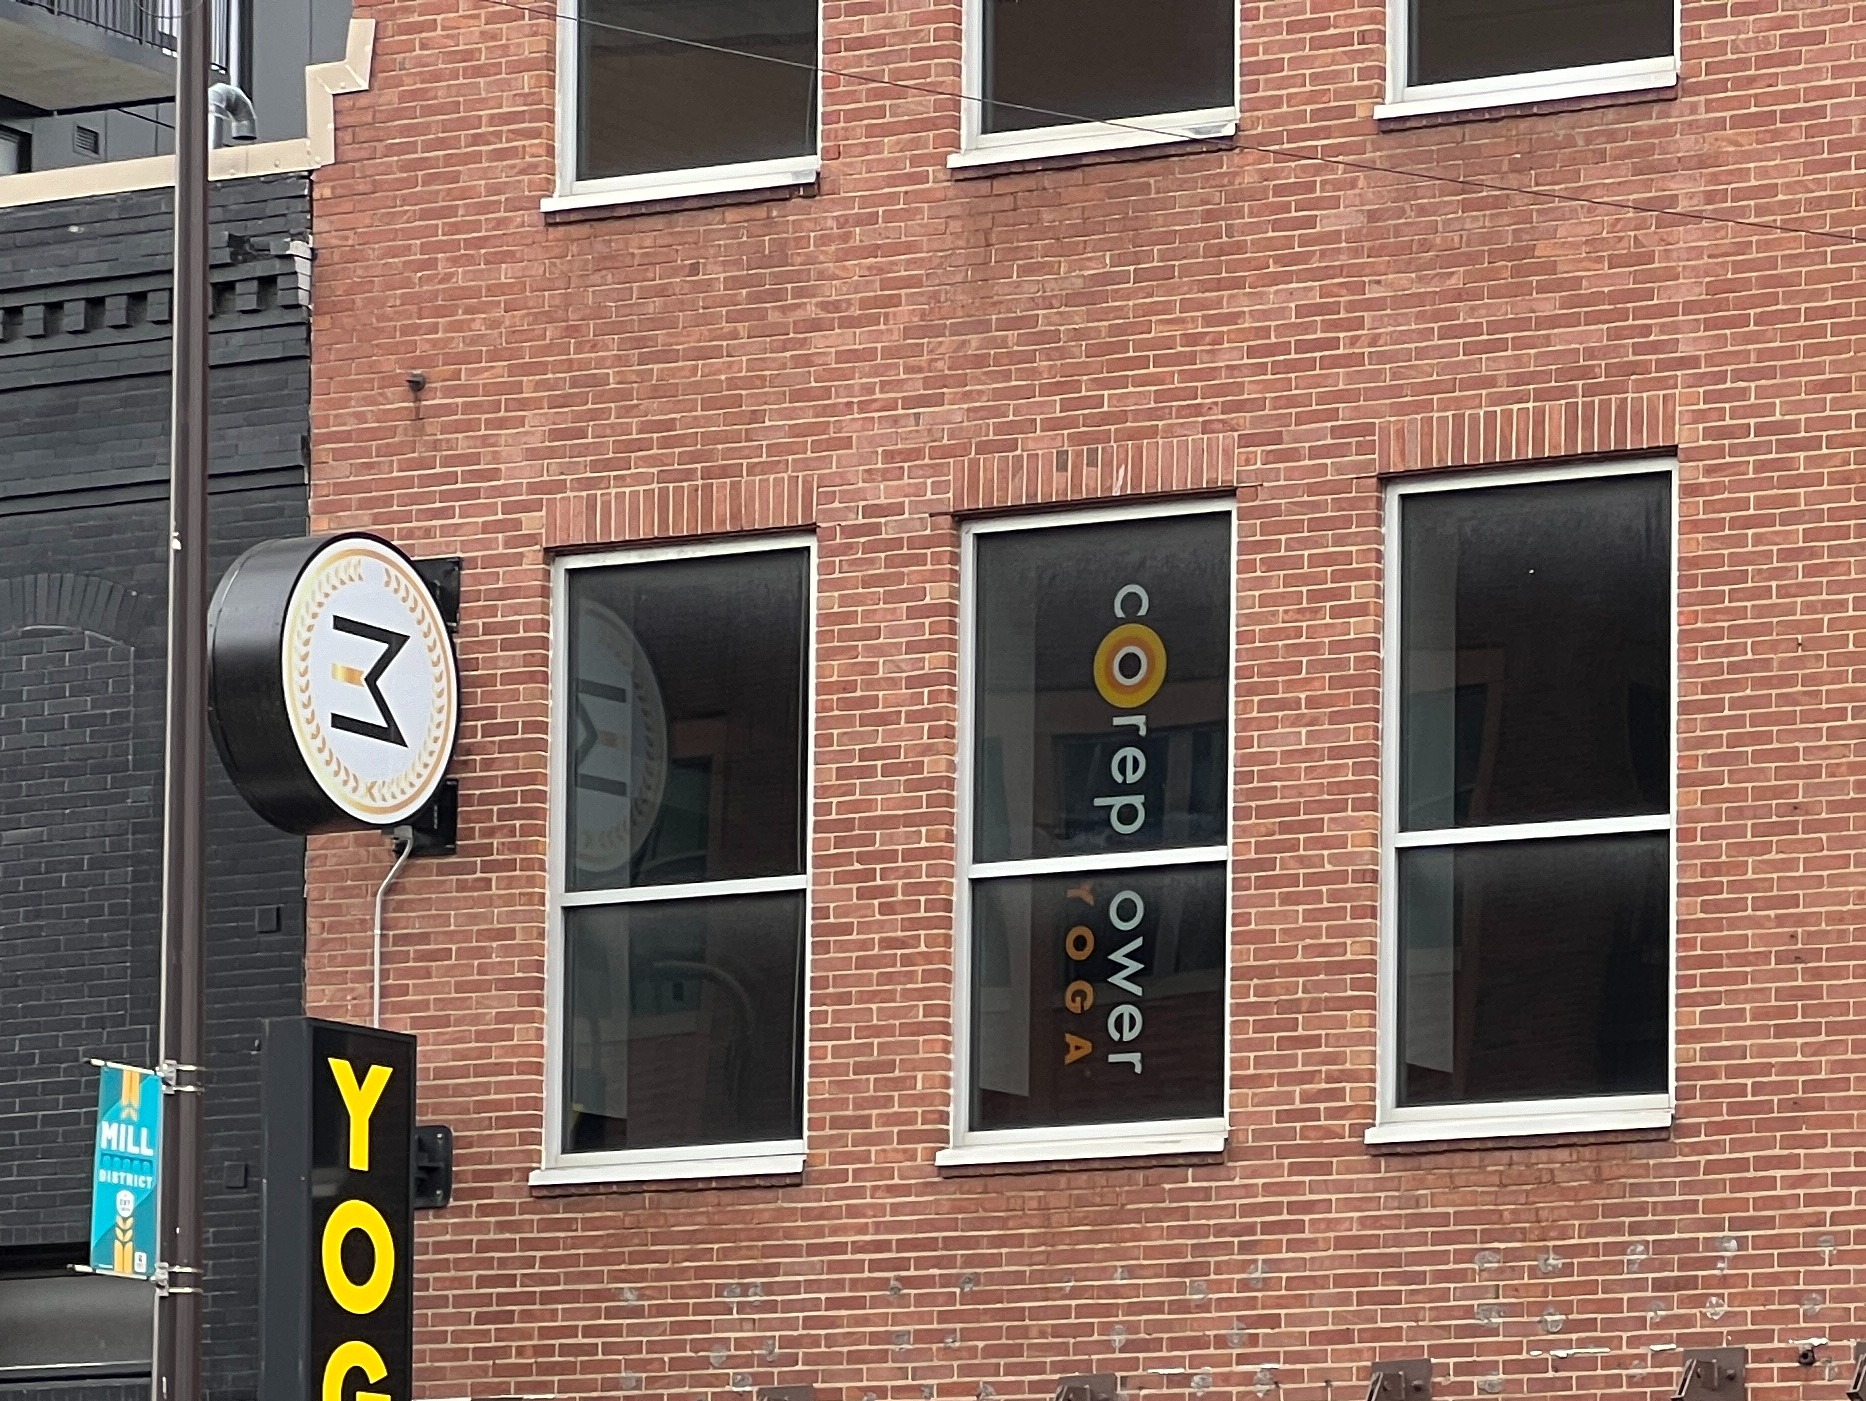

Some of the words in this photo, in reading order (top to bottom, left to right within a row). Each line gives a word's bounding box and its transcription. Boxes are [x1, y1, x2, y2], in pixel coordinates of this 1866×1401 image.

[1065, 881, 1095, 1066] YOGA
[101, 1121, 154, 1157] MILL
[99, 1169, 153, 1189] DISTRICT
